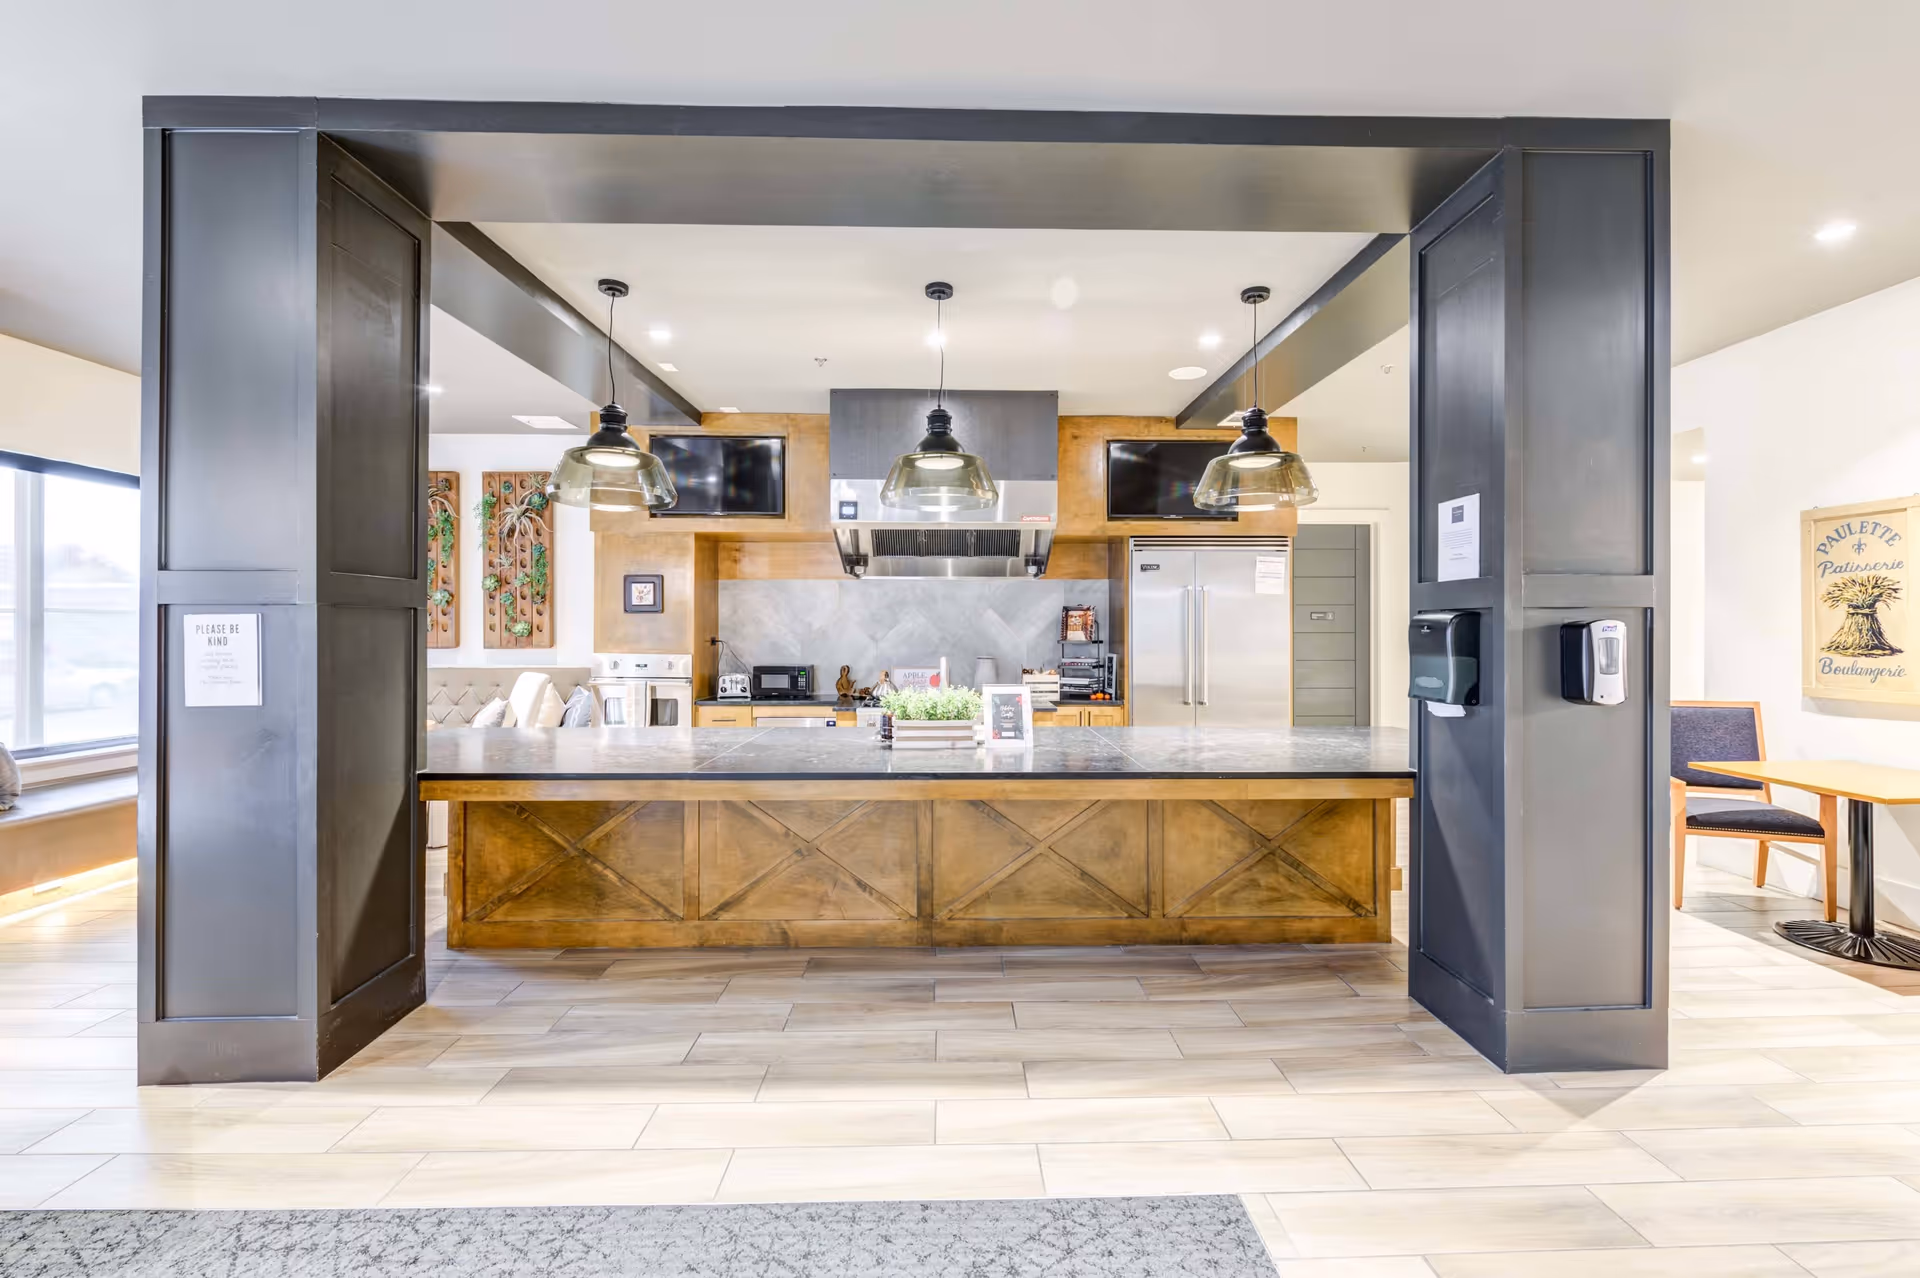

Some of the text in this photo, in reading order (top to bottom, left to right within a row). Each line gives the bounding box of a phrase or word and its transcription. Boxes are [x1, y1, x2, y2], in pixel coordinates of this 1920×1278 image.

[1816, 520, 1902, 556] PAULETTE
[1817, 558, 1905, 579] Patisserie
[195, 623, 240, 635] PLEASE BE
[207, 636, 228, 647] KIND
[1818, 656, 1908, 684] Boulangerie
